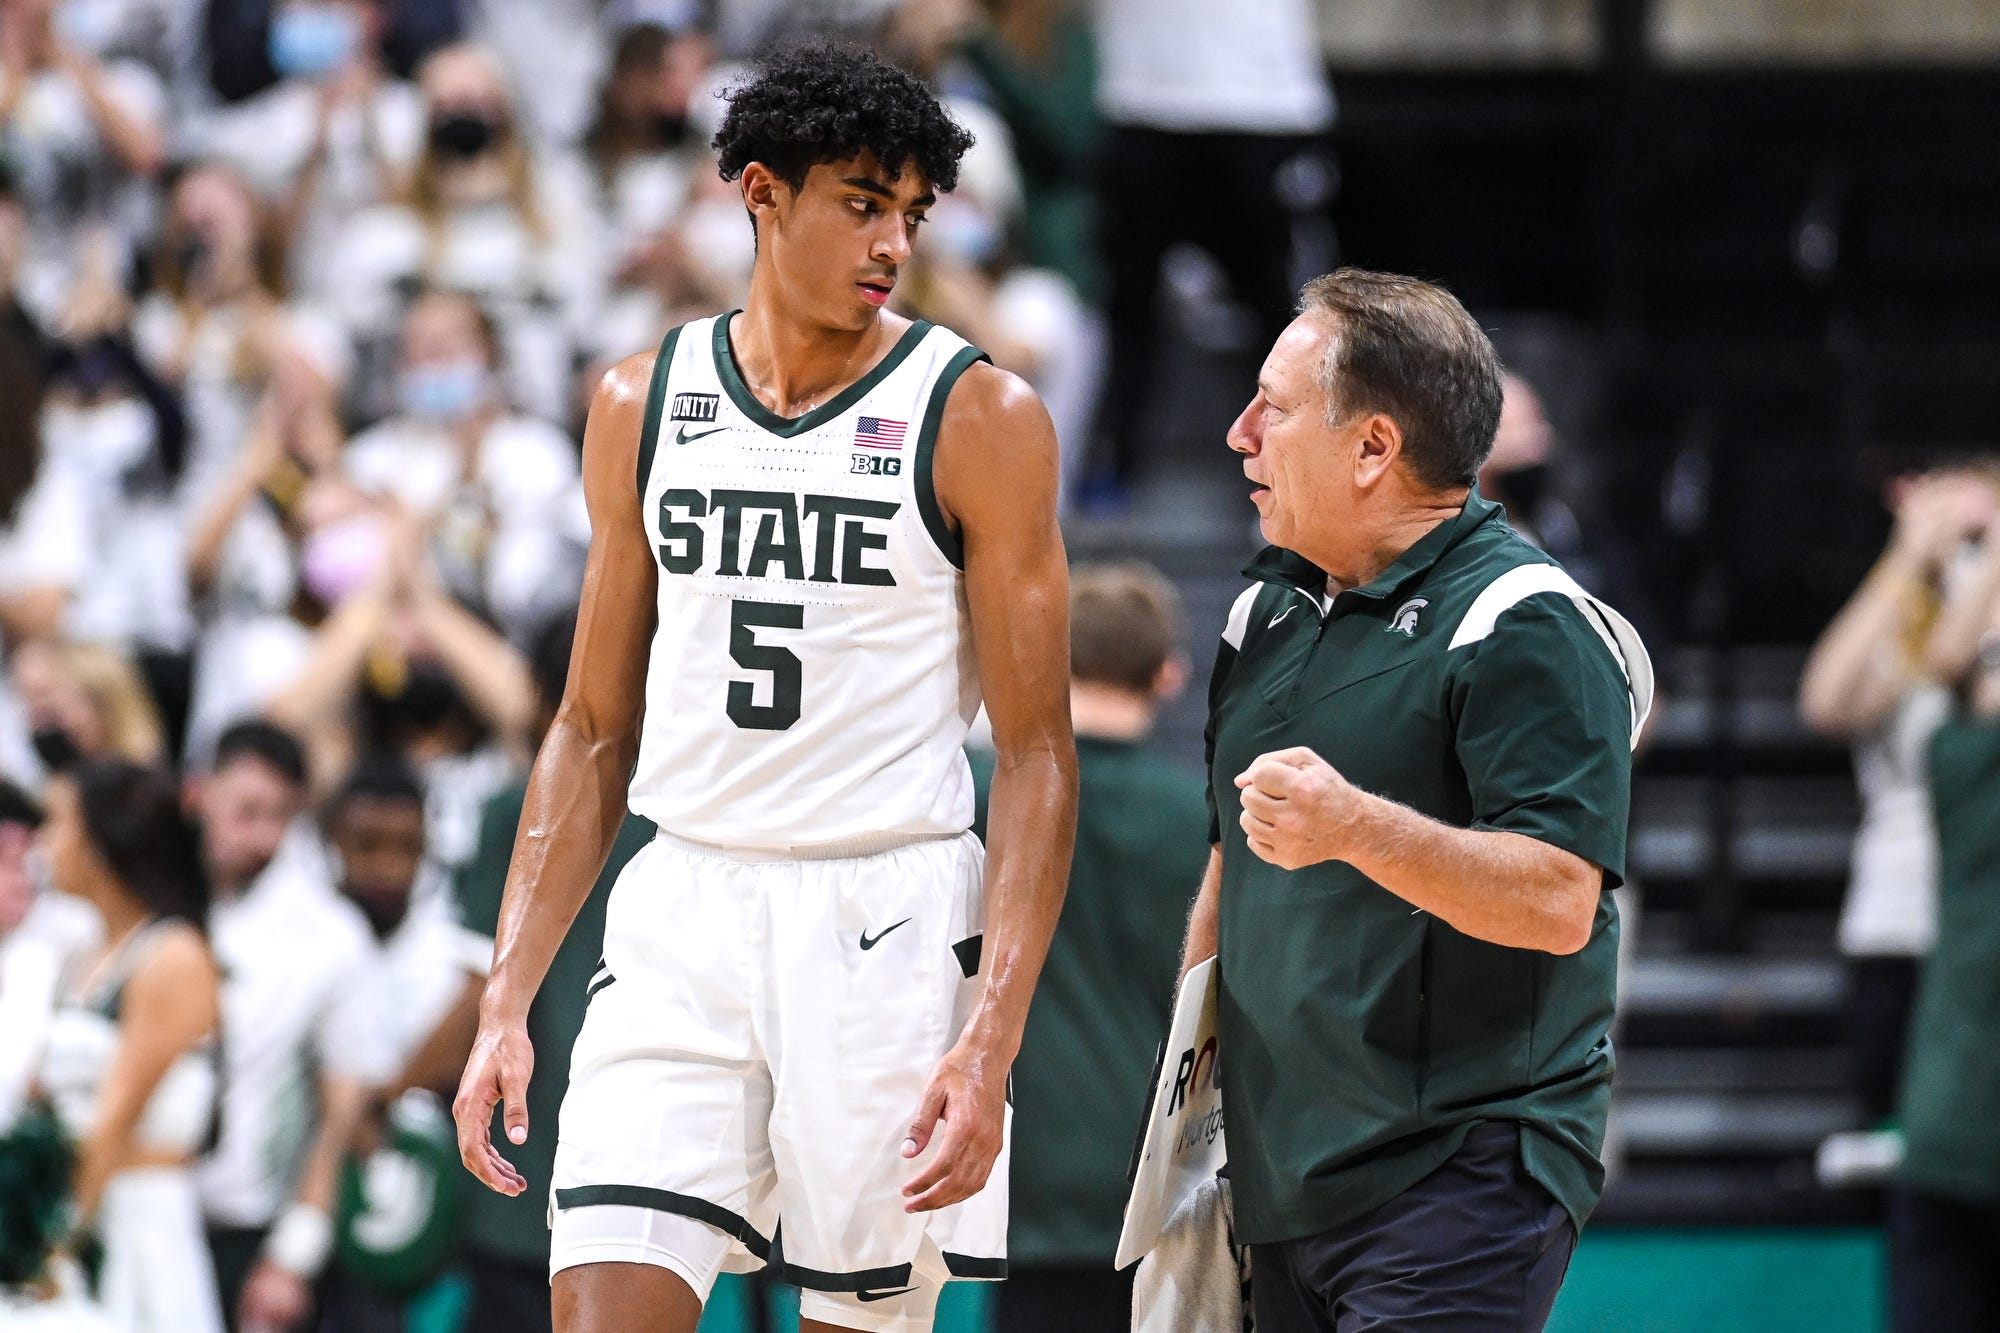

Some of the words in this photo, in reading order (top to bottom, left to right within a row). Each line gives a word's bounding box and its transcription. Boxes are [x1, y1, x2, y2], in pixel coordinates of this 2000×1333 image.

[672, 395, 718, 418] UNITY
[659, 488, 901, 587] STATE
[726, 599, 804, 731] 5
